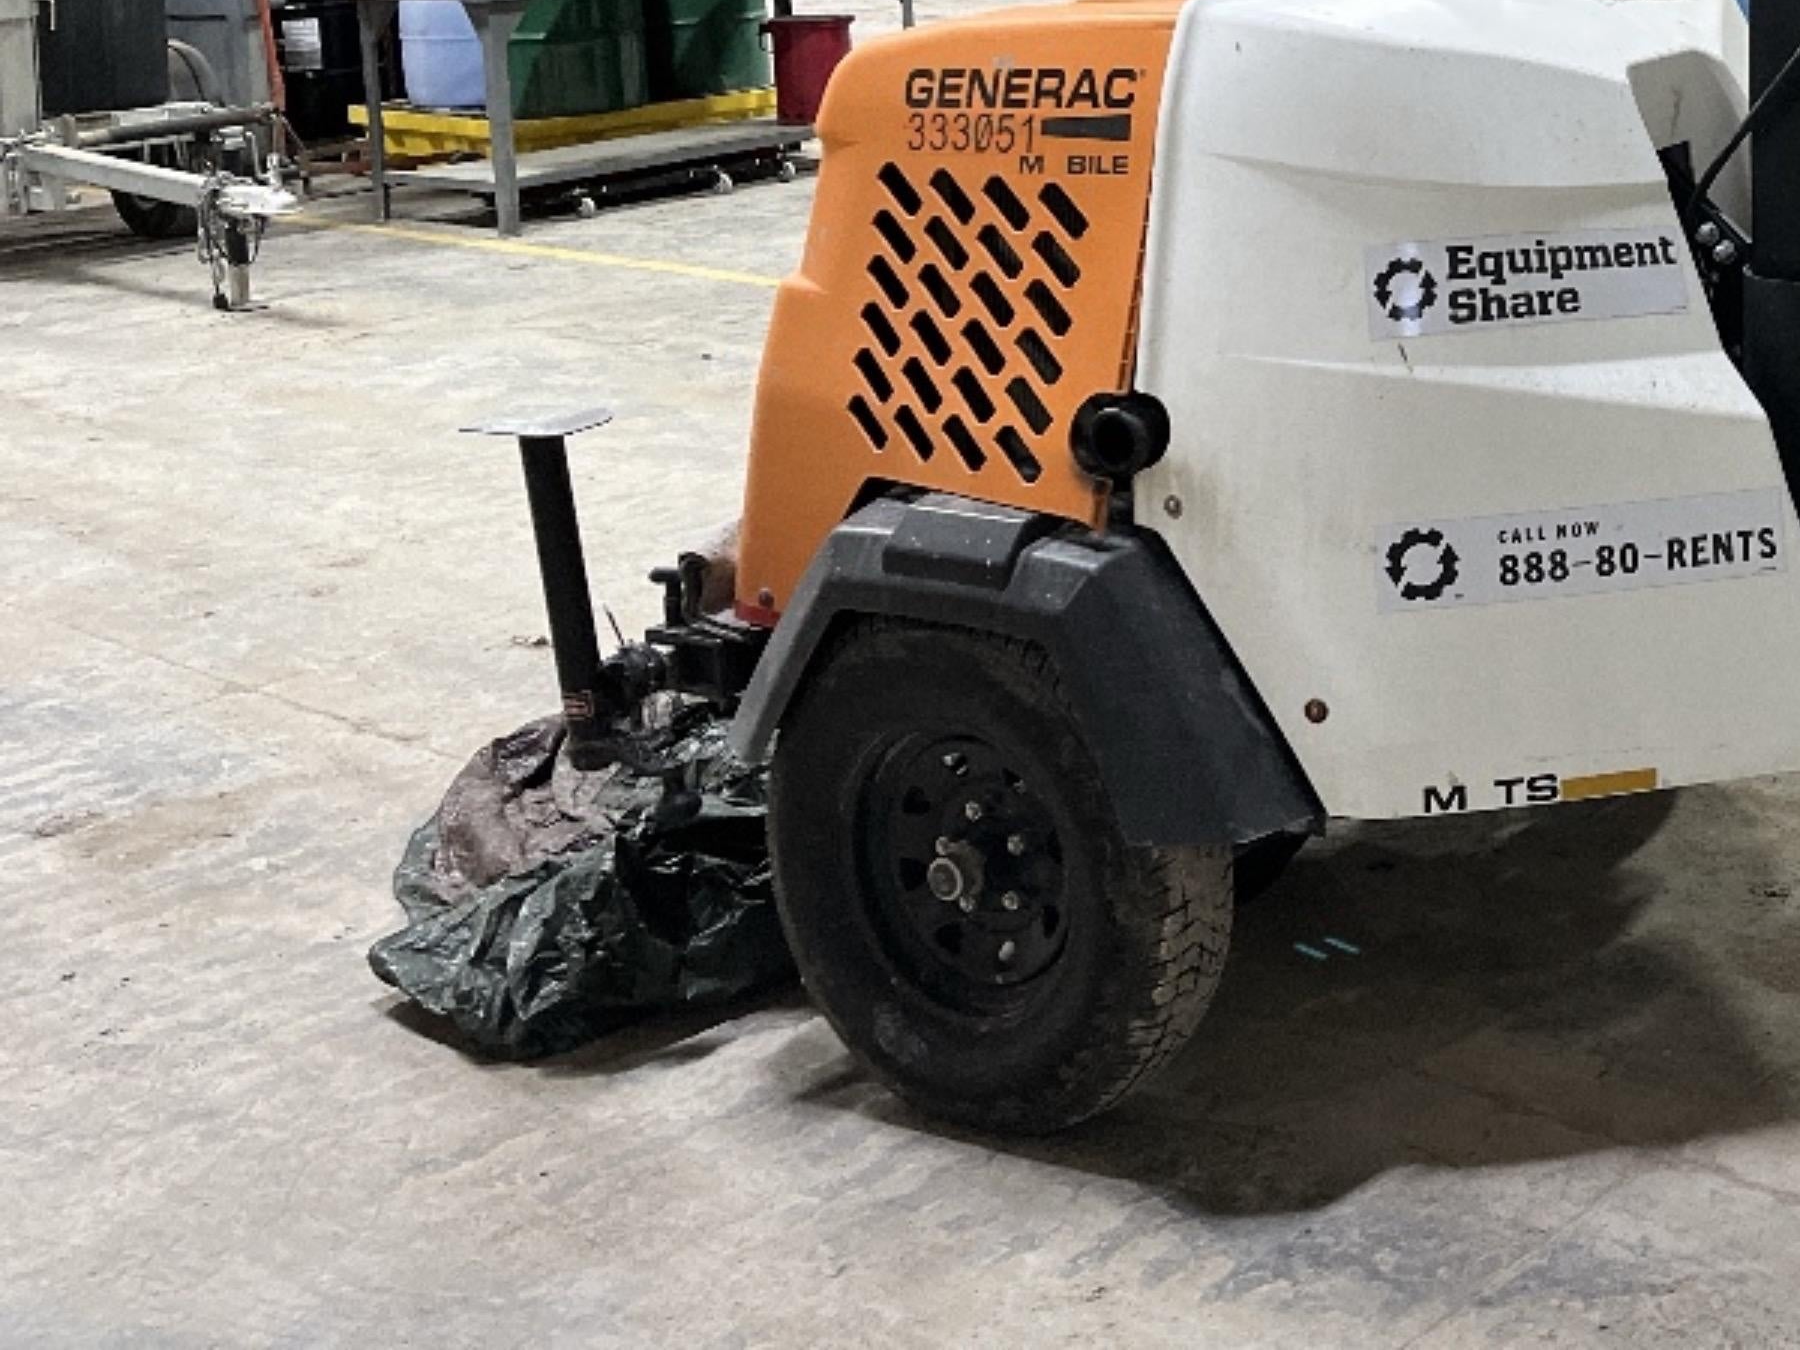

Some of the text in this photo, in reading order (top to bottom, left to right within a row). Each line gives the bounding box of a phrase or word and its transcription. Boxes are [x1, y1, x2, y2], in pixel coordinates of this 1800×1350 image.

[905, 68, 1138, 109] GENERAC
[907, 112, 1036, 154] 333051
[1018, 154, 1130, 175] MBILE
[1446, 235, 1678, 286] Equipment
[1448, 287, 1582, 324] Share
[1498, 520, 1600, 545] CALL NOW
[1499, 527, 1778, 586] 888-80-RENTS
